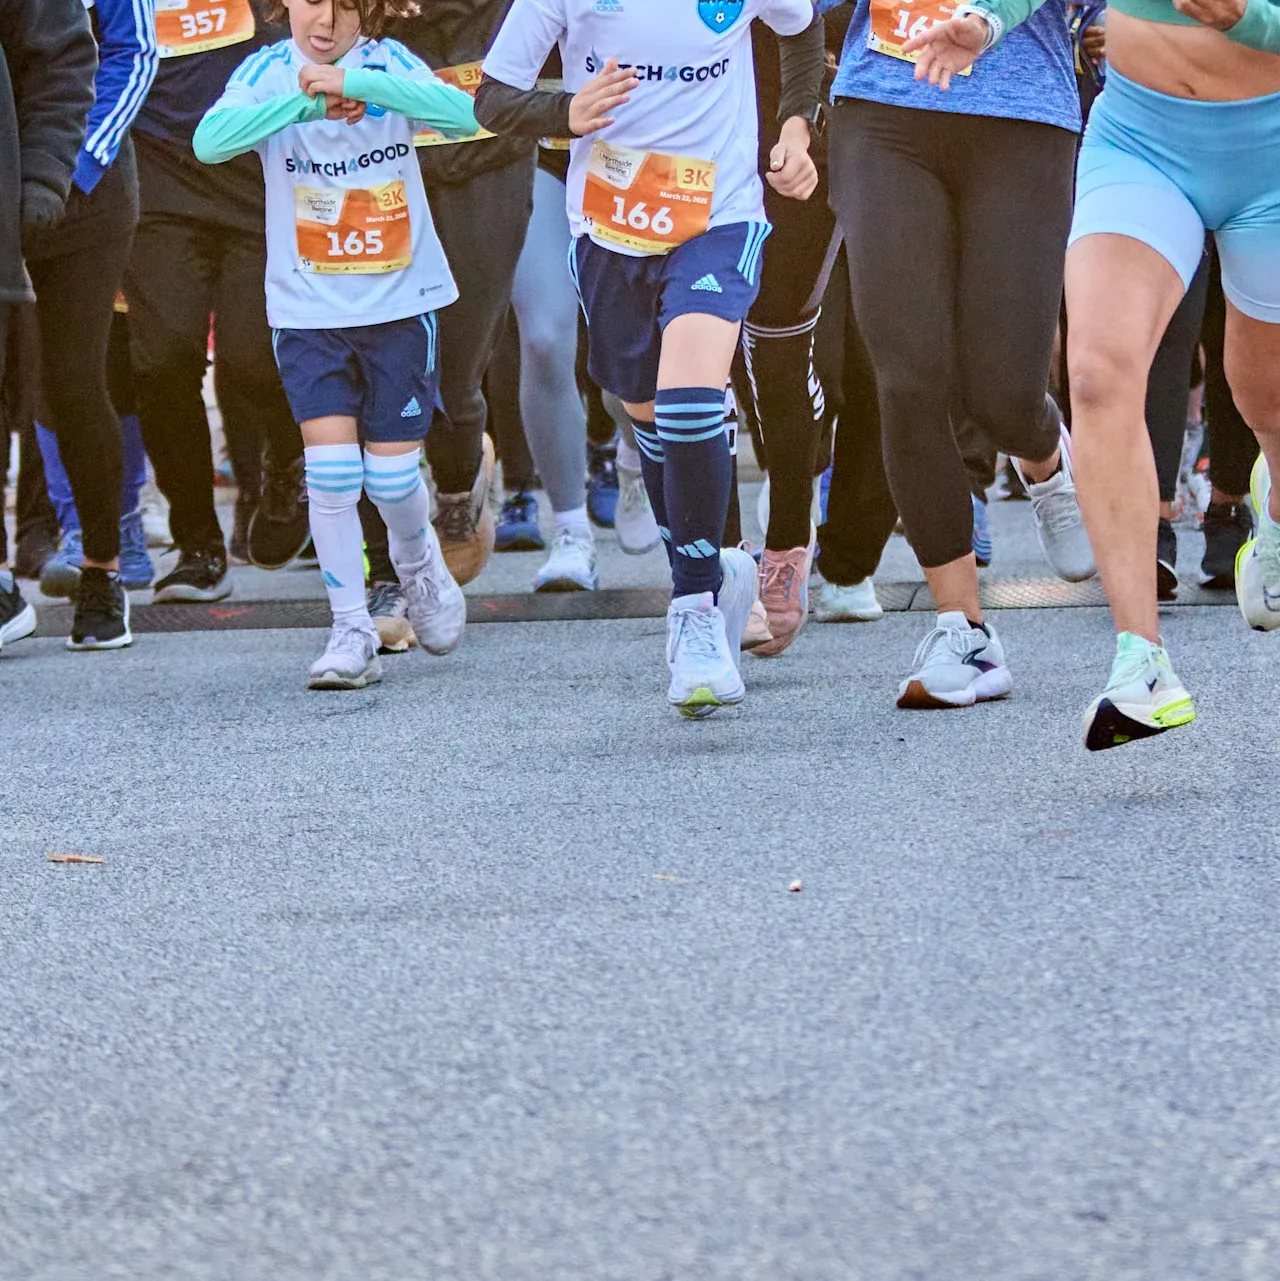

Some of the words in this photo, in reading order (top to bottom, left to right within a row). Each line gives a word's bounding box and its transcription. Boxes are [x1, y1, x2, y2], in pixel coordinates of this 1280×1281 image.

[592, 2, 624, 12] adidas
[179, 7, 228, 39] 357
[893, 9, 946, 40] 16
[601, 153, 634, 168] Northside
[682, 168, 711, 188] 3K
[306, 198, 337, 206] Northside
[382, 188, 404, 207] 3K
[659, 190, 681, 202] March
[681, 194, 692, 203] 22,
[692, 196, 709, 205] 2025
[365, 215, 385, 223] March
[385, 214, 395, 223] 22,
[611, 195, 674, 236] 166
[327, 230, 384, 257] 165
[691, 284, 723, 294] adidas
[400, 408, 422, 418] adidas
